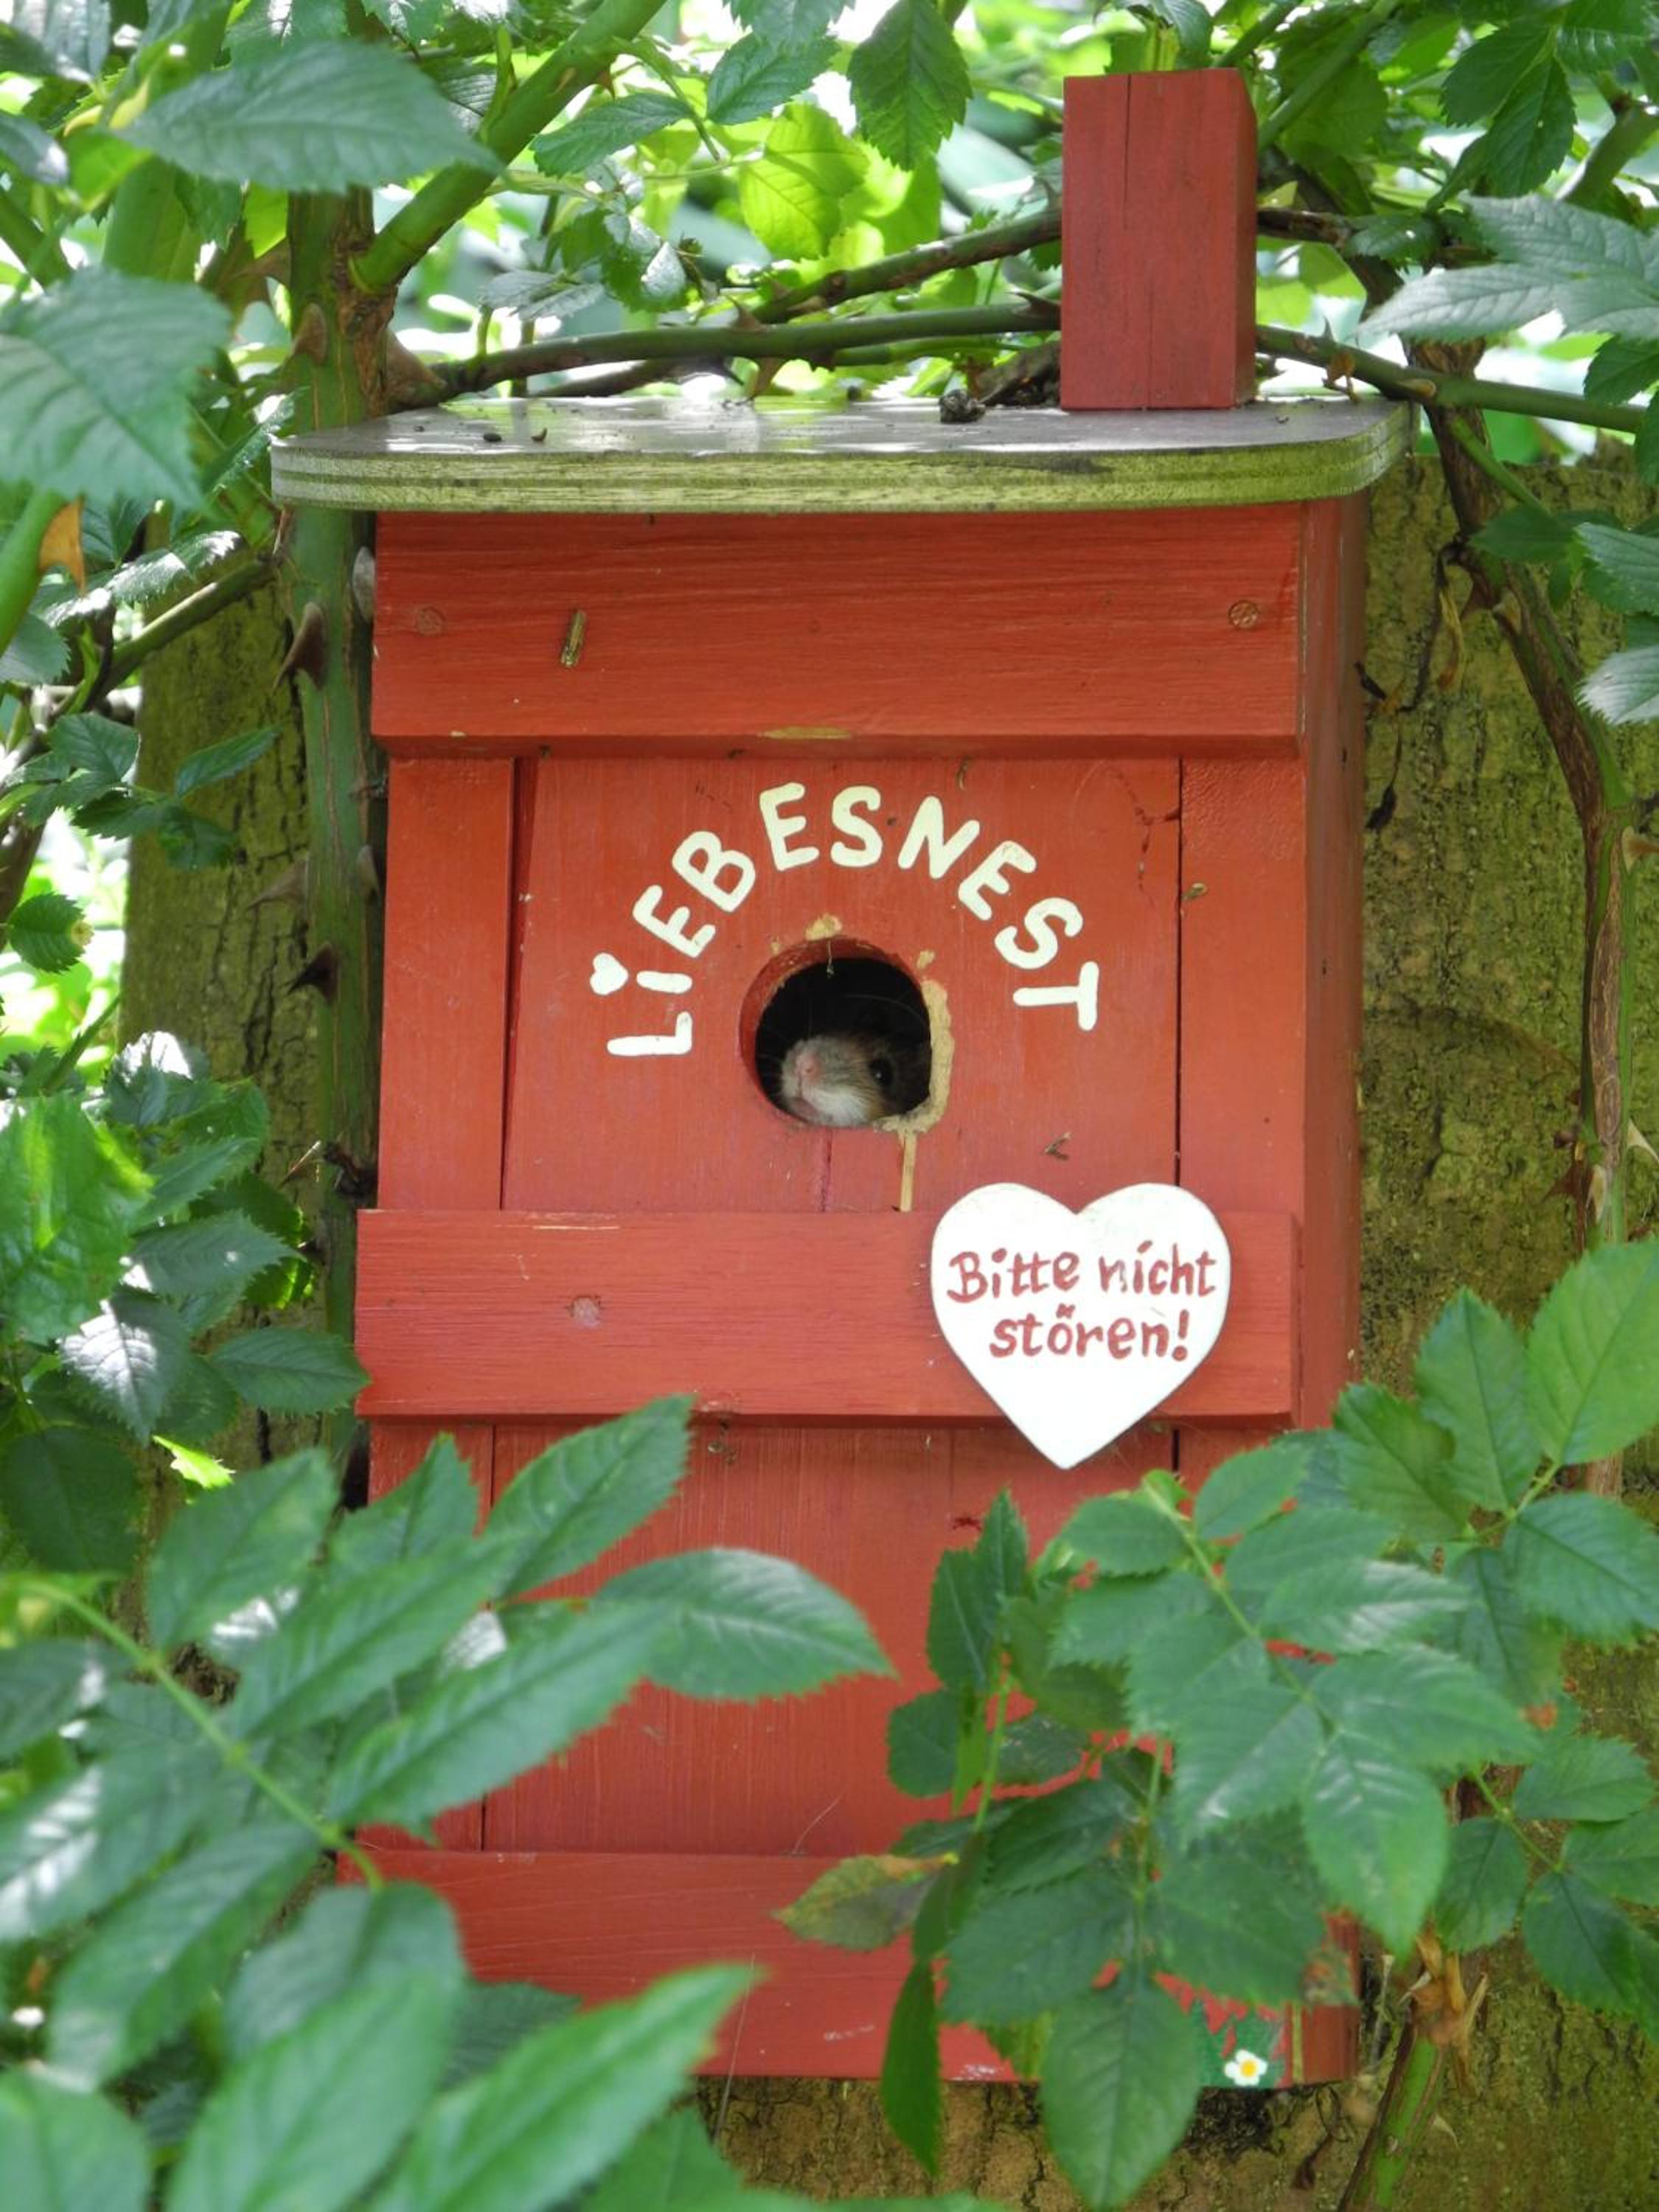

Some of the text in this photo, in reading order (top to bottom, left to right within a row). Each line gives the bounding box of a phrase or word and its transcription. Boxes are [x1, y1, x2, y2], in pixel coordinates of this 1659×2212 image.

[590, 782, 1100, 1058] LIEBESNEST
[947, 1239, 1217, 1304] Bitte nicht
[989, 1303, 1190, 1363] stören!
